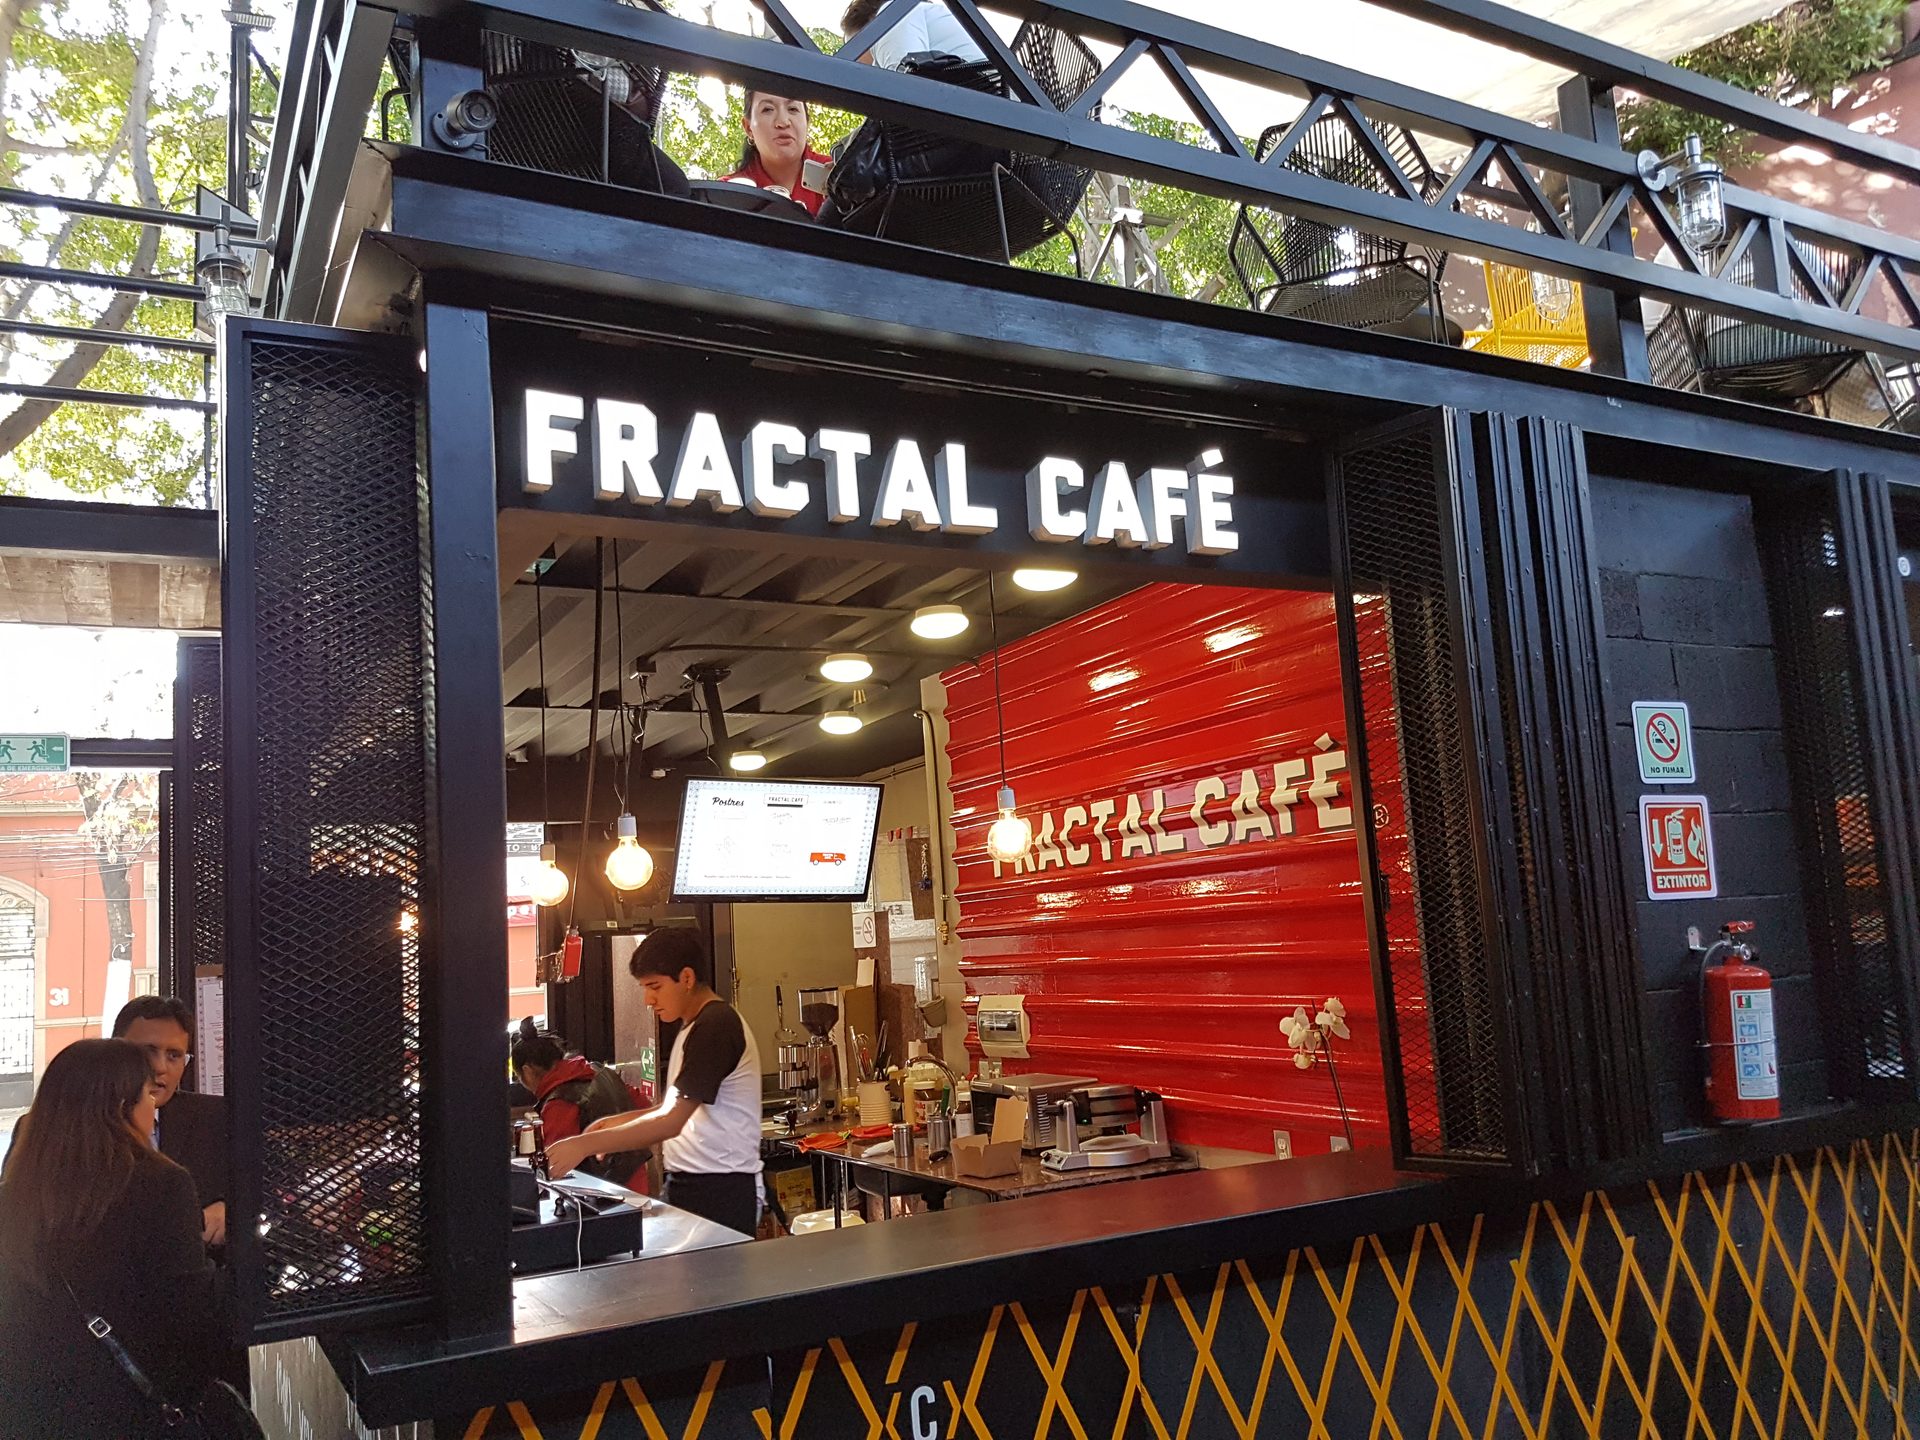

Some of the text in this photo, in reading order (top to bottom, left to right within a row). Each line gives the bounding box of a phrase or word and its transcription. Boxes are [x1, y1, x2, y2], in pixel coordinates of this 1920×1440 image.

[523, 388, 1240, 556] FRACTAL CAFÉ
[1650, 766, 1685, 774] NO FUMAR
[712, 796, 745, 807] Postres
[992, 732, 1353, 878] RACTAL CAFÉ
[1656, 873, 1708, 889] EXTINTOR
[49, 987, 70, 1006] 31
